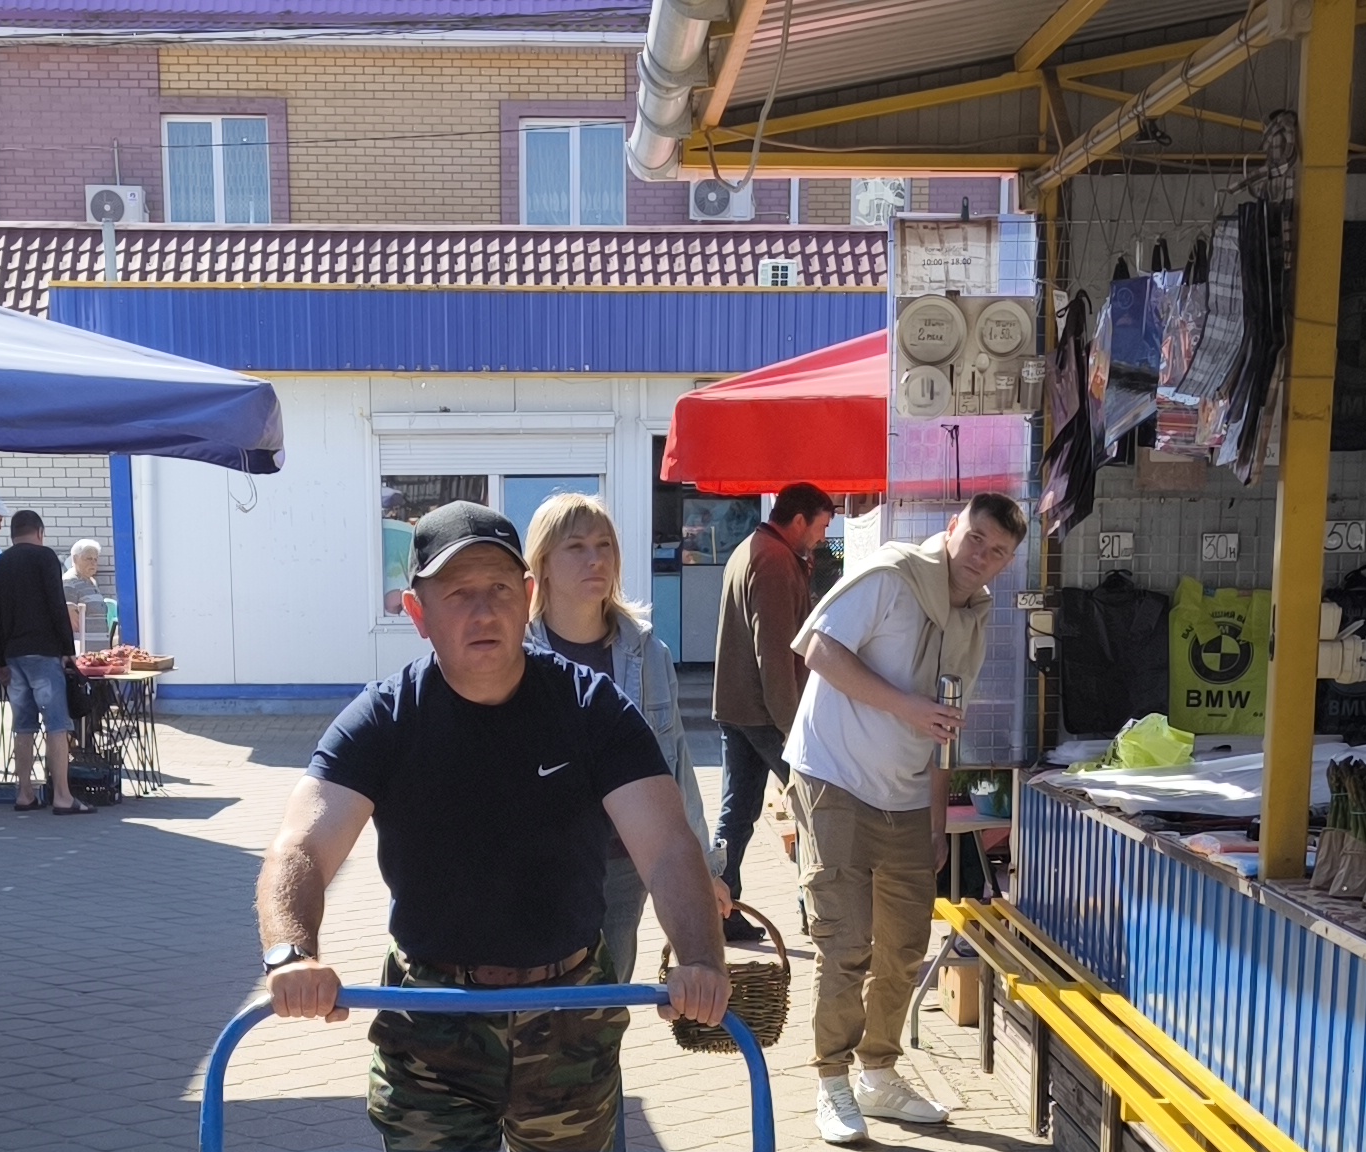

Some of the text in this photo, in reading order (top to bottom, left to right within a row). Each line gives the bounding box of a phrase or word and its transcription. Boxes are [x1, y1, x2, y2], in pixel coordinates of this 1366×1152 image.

[922, 258, 942, 266] 10:00
[951, 257, 972, 266] 18:00
[1185, 689, 1252, 709] BMW
